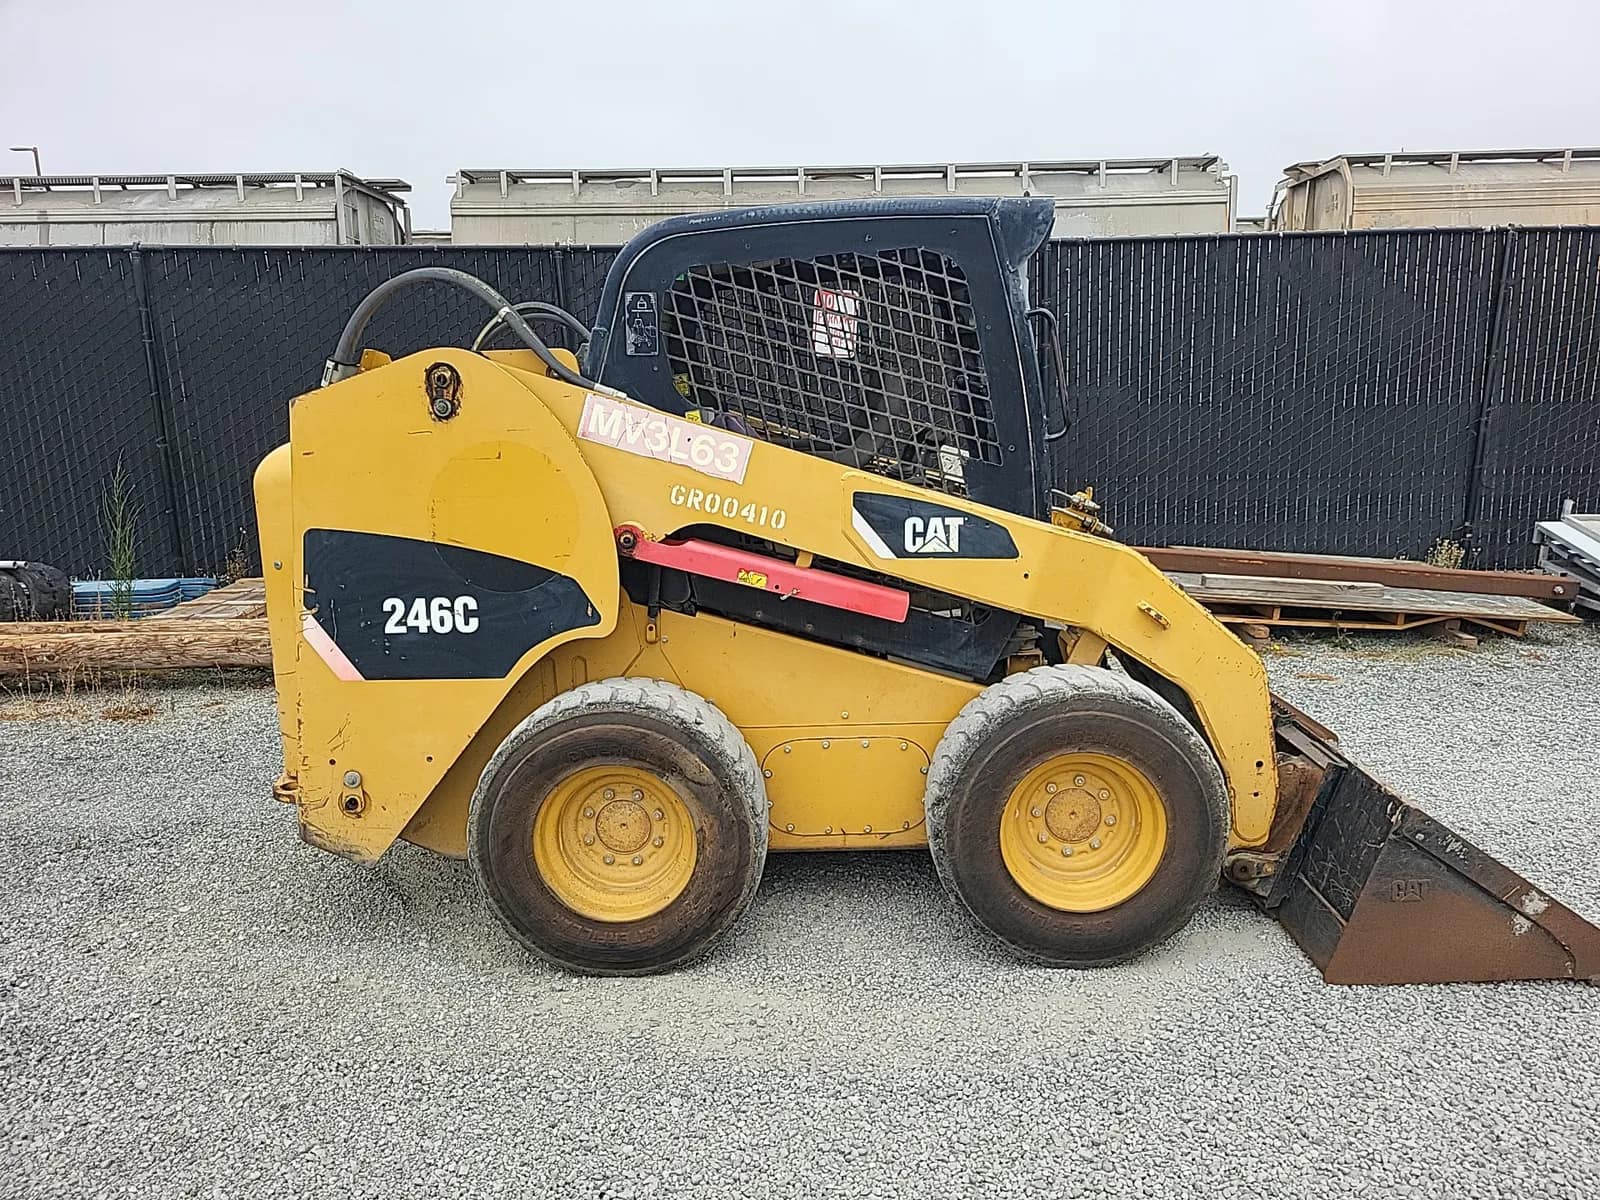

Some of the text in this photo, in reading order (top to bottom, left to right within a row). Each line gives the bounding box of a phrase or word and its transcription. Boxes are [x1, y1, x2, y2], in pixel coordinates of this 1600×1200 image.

[588, 402, 740, 473] MV3L63
[904, 516, 964, 553] CAT
[382, 595, 480, 634] 246C
[1391, 878, 1431, 902] CAT
